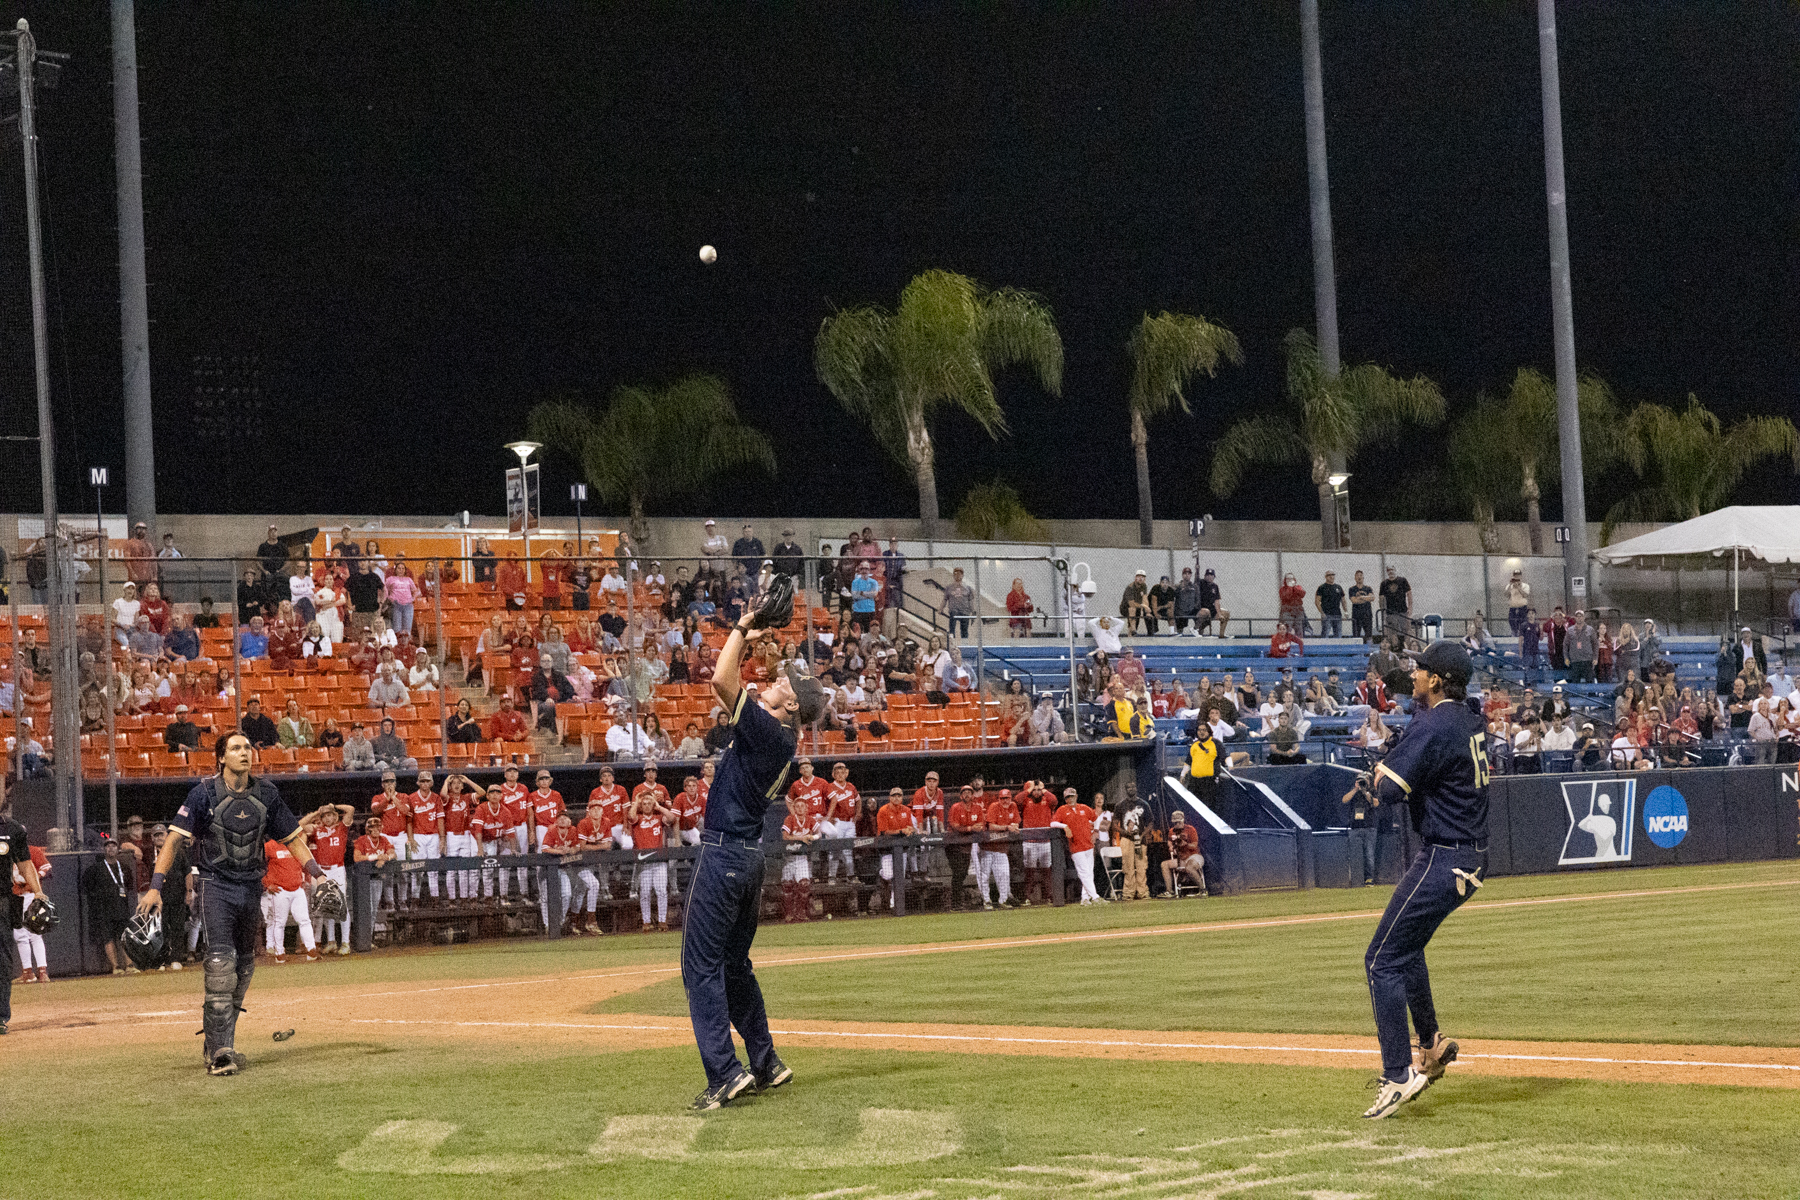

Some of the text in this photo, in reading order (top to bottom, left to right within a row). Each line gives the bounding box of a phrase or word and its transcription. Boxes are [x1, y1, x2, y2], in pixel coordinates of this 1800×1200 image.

[91, 468, 106, 485] M
[578, 485, 586, 499] N
[1198, 521, 1204, 534] P
[1469, 732, 1490, 788] 15
[812, 797, 822, 806] 37
[1648, 815, 1688, 833] NCAA
[329, 837, 340, 846] 12
